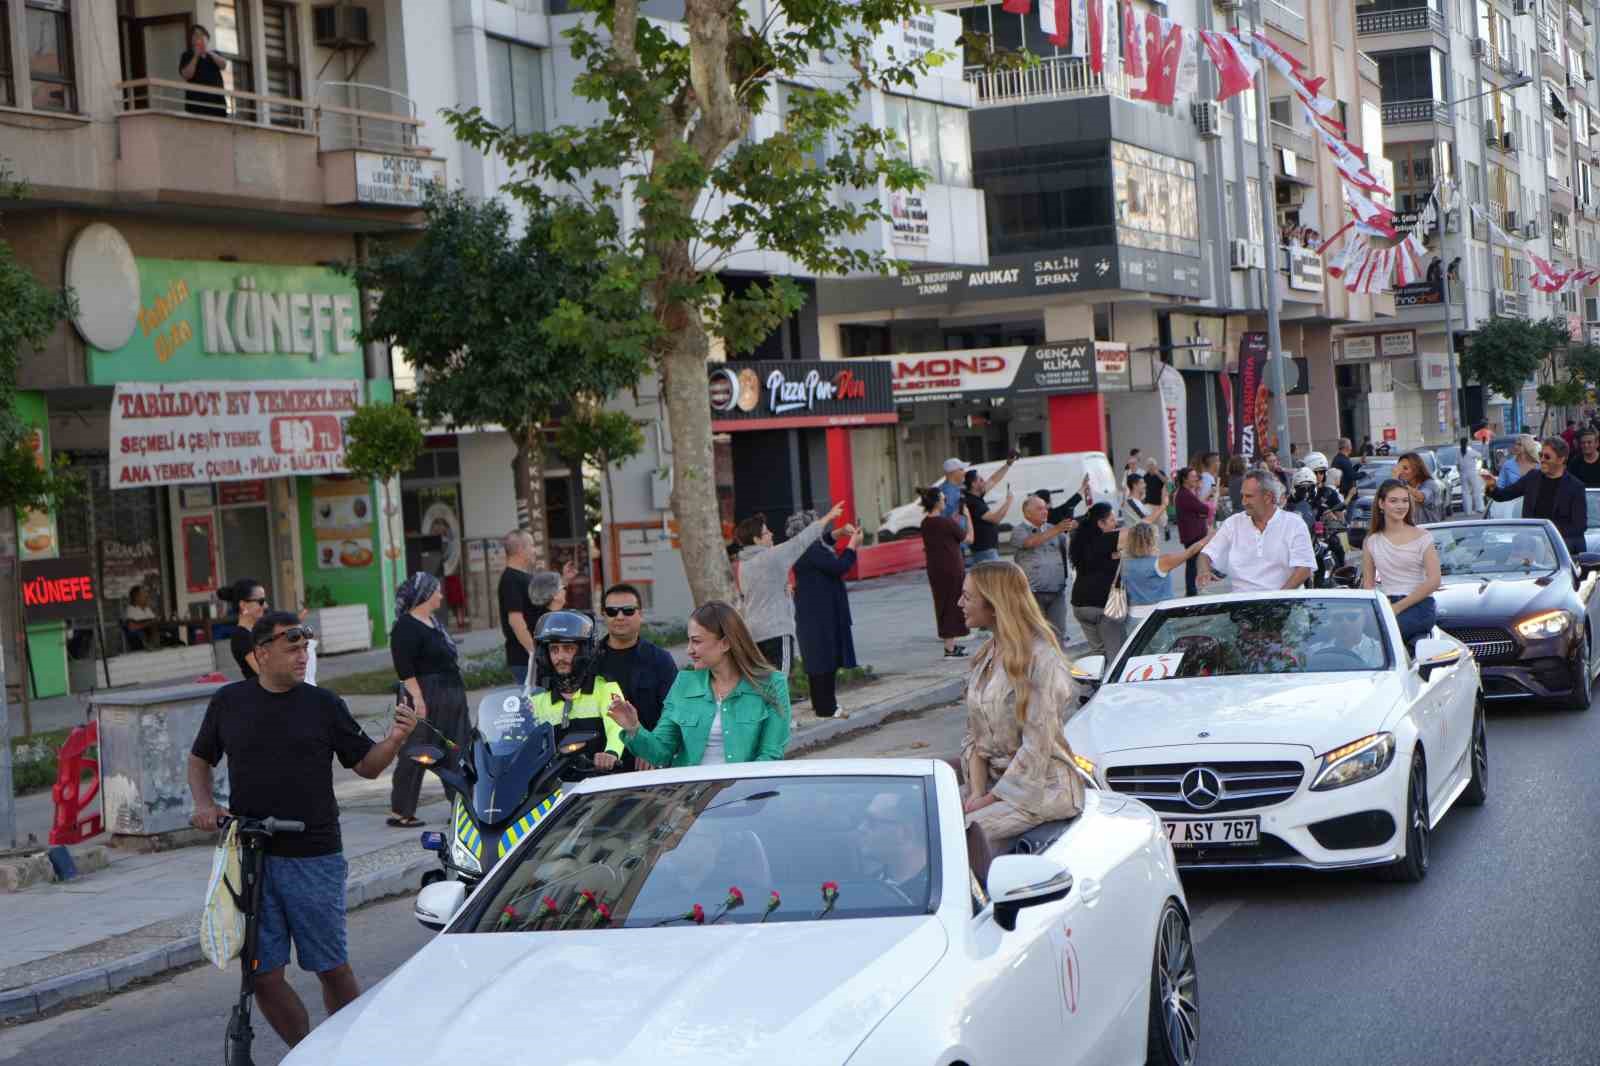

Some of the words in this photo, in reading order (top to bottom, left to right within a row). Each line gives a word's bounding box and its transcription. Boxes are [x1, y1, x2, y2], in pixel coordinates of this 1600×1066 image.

[1033, 256, 1079, 272] SALİH
[968, 268, 1019, 287] AVUKAT
[1035, 272, 1079, 286] ERBAY
[203, 275, 356, 361] KÜNEFE
[892, 356, 1005, 379] MOND
[1043, 357, 1080, 371] KLİMA
[226, 391, 251, 415] EV
[254, 383, 359, 414] YEMEKLERİ
[120, 426, 175, 456] SEÇMELİ
[178, 435, 186, 449] 4
[188, 428, 221, 453] ÇEŞİT
[223, 430, 261, 448] YEMEK
[319, 432, 335, 449] TL
[120, 465, 151, 482] ANA
[153, 463, 194, 481] YEMEK
[251, 457, 280, 475] PİLAV
[23, 576, 94, 606] KÜNEFE
[1163, 823, 1177, 841] 7
[1185, 823, 1213, 841] ASY
[1223, 821, 1254, 840] 767
